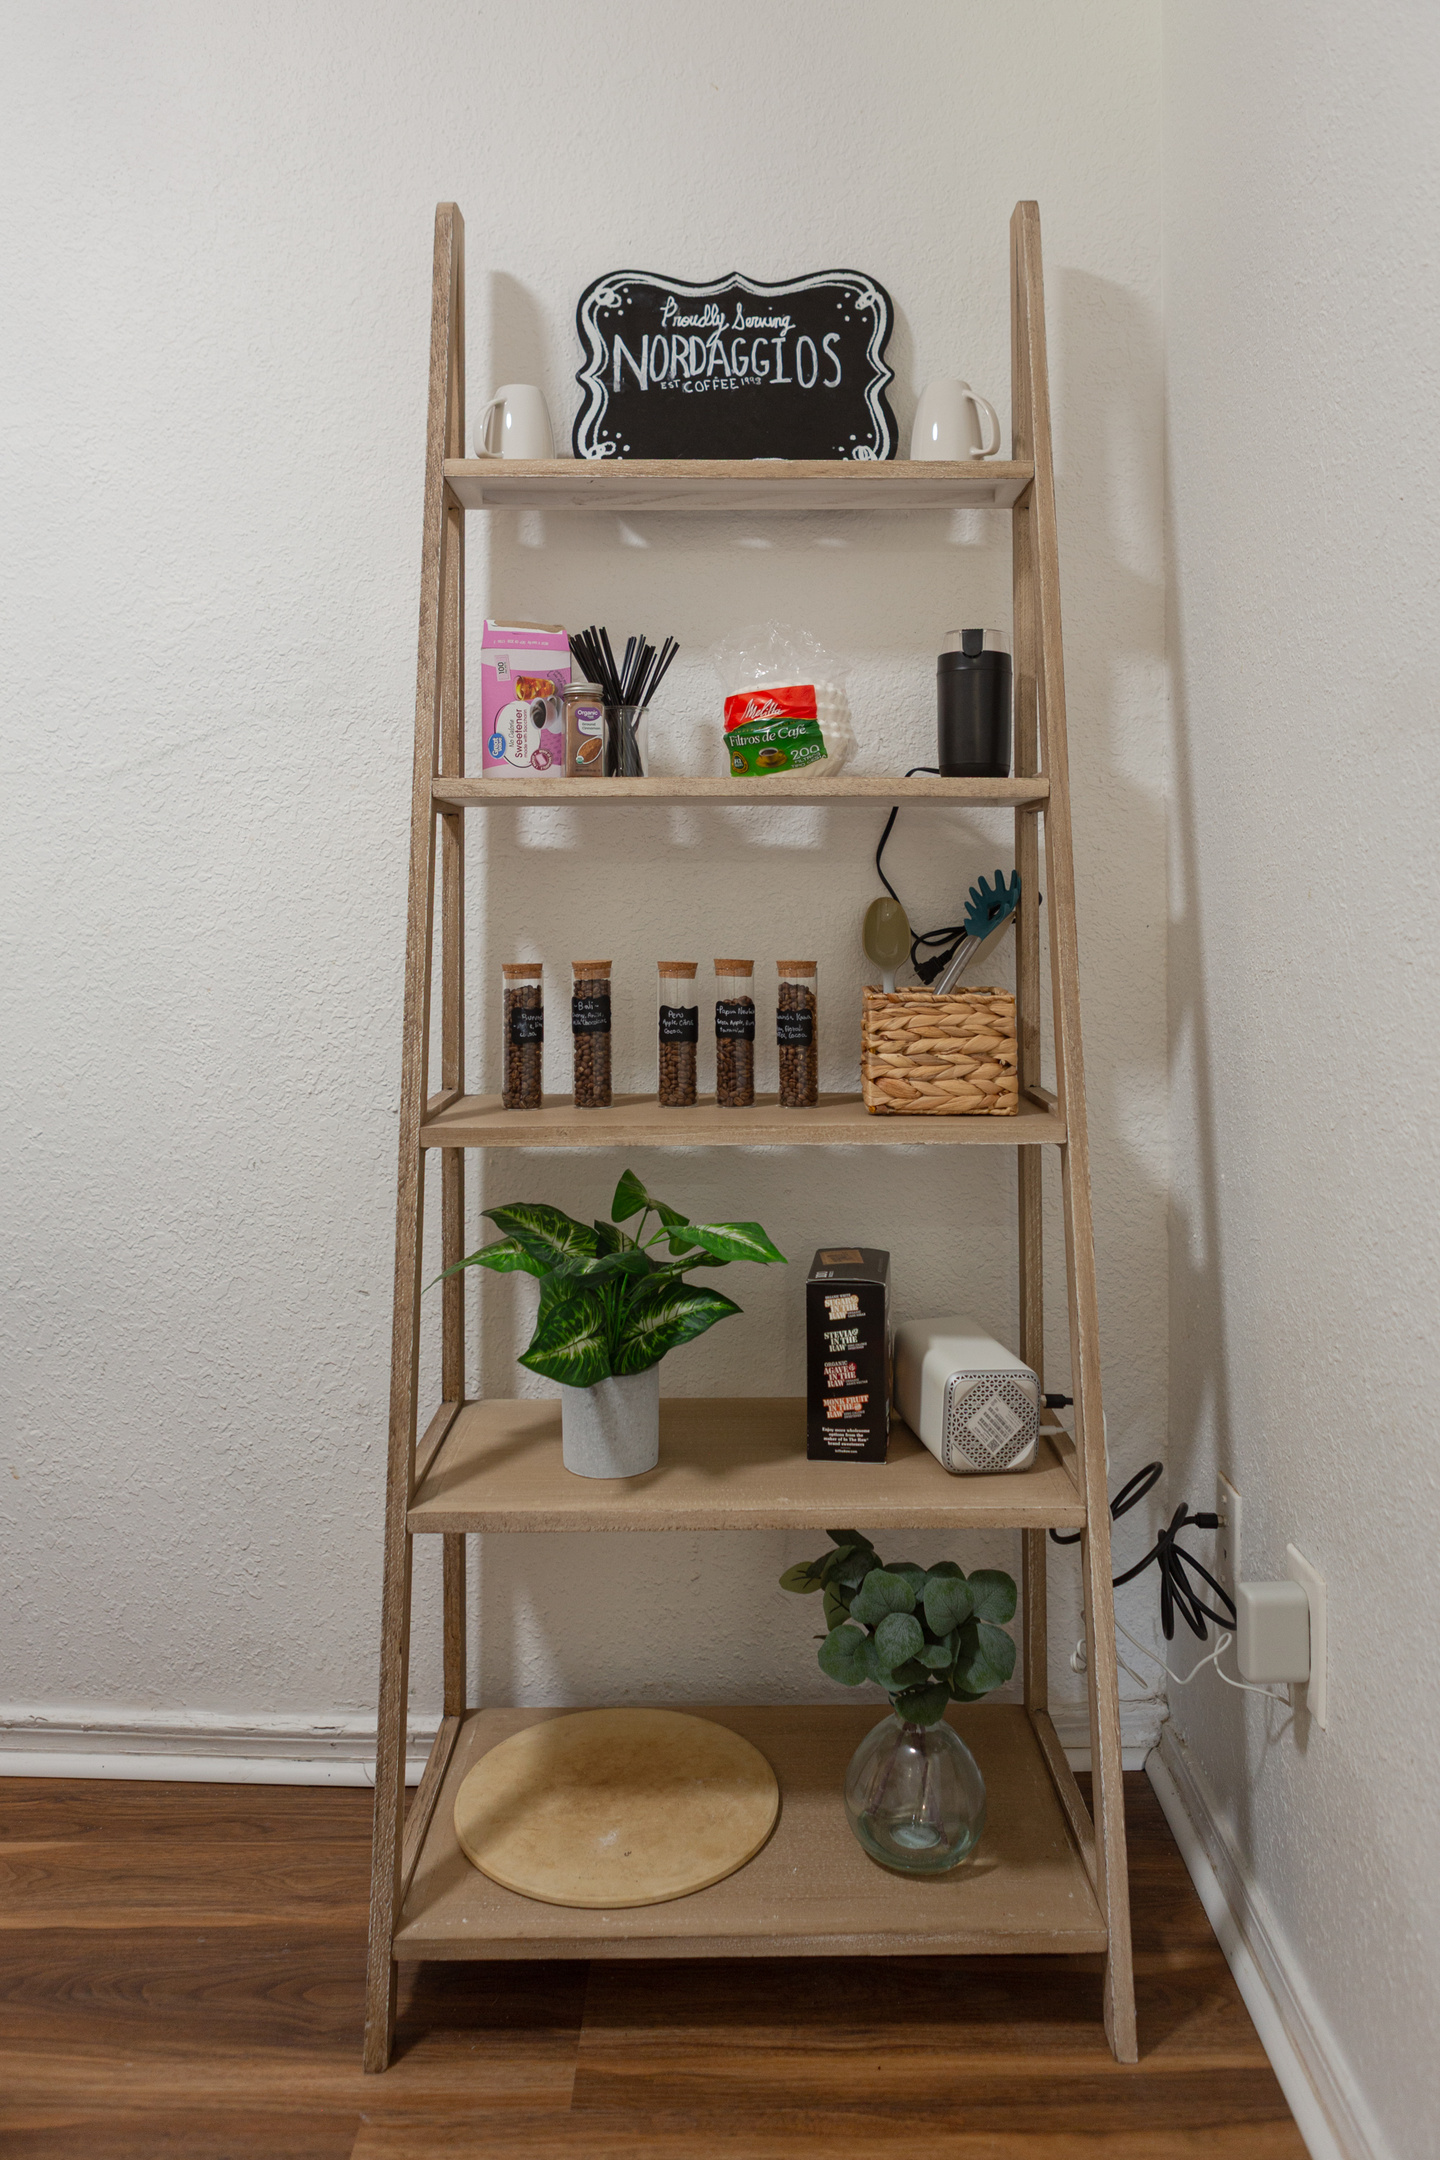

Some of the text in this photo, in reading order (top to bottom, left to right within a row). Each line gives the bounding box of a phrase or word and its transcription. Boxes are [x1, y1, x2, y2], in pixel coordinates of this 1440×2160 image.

[659, 295, 796, 347] Proudly Serving
[612, 332, 842, 393] NORDAGGIOS
[660, 379, 681, 390] EST
[682, 377, 739, 393] COFFEE
[740, 698, 785, 722] Melitta
[514, 709, 523, 758] Sweetener
[729, 734, 760, 746] Filtros
[762, 730, 776, 742] de
[778, 724, 806, 739] Café
[492, 738, 500, 756] Great
[790, 744, 820, 760] 200
[824, 1296, 852, 1308] SUGAR
[830, 1303, 858, 1312] IN THE
[828, 1312, 846, 1320] RAW
[824, 1330, 852, 1340] STEVIA
[828, 1344, 846, 1352] RAW
[824, 1366, 848, 1375] AGAVE
[838, 1371, 856, 1379] THE
[827, 1380, 844, 1388] RAW
[823, 1394, 869, 1407] MONK FRUIT
[826, 1411, 843, 1419] RAW
